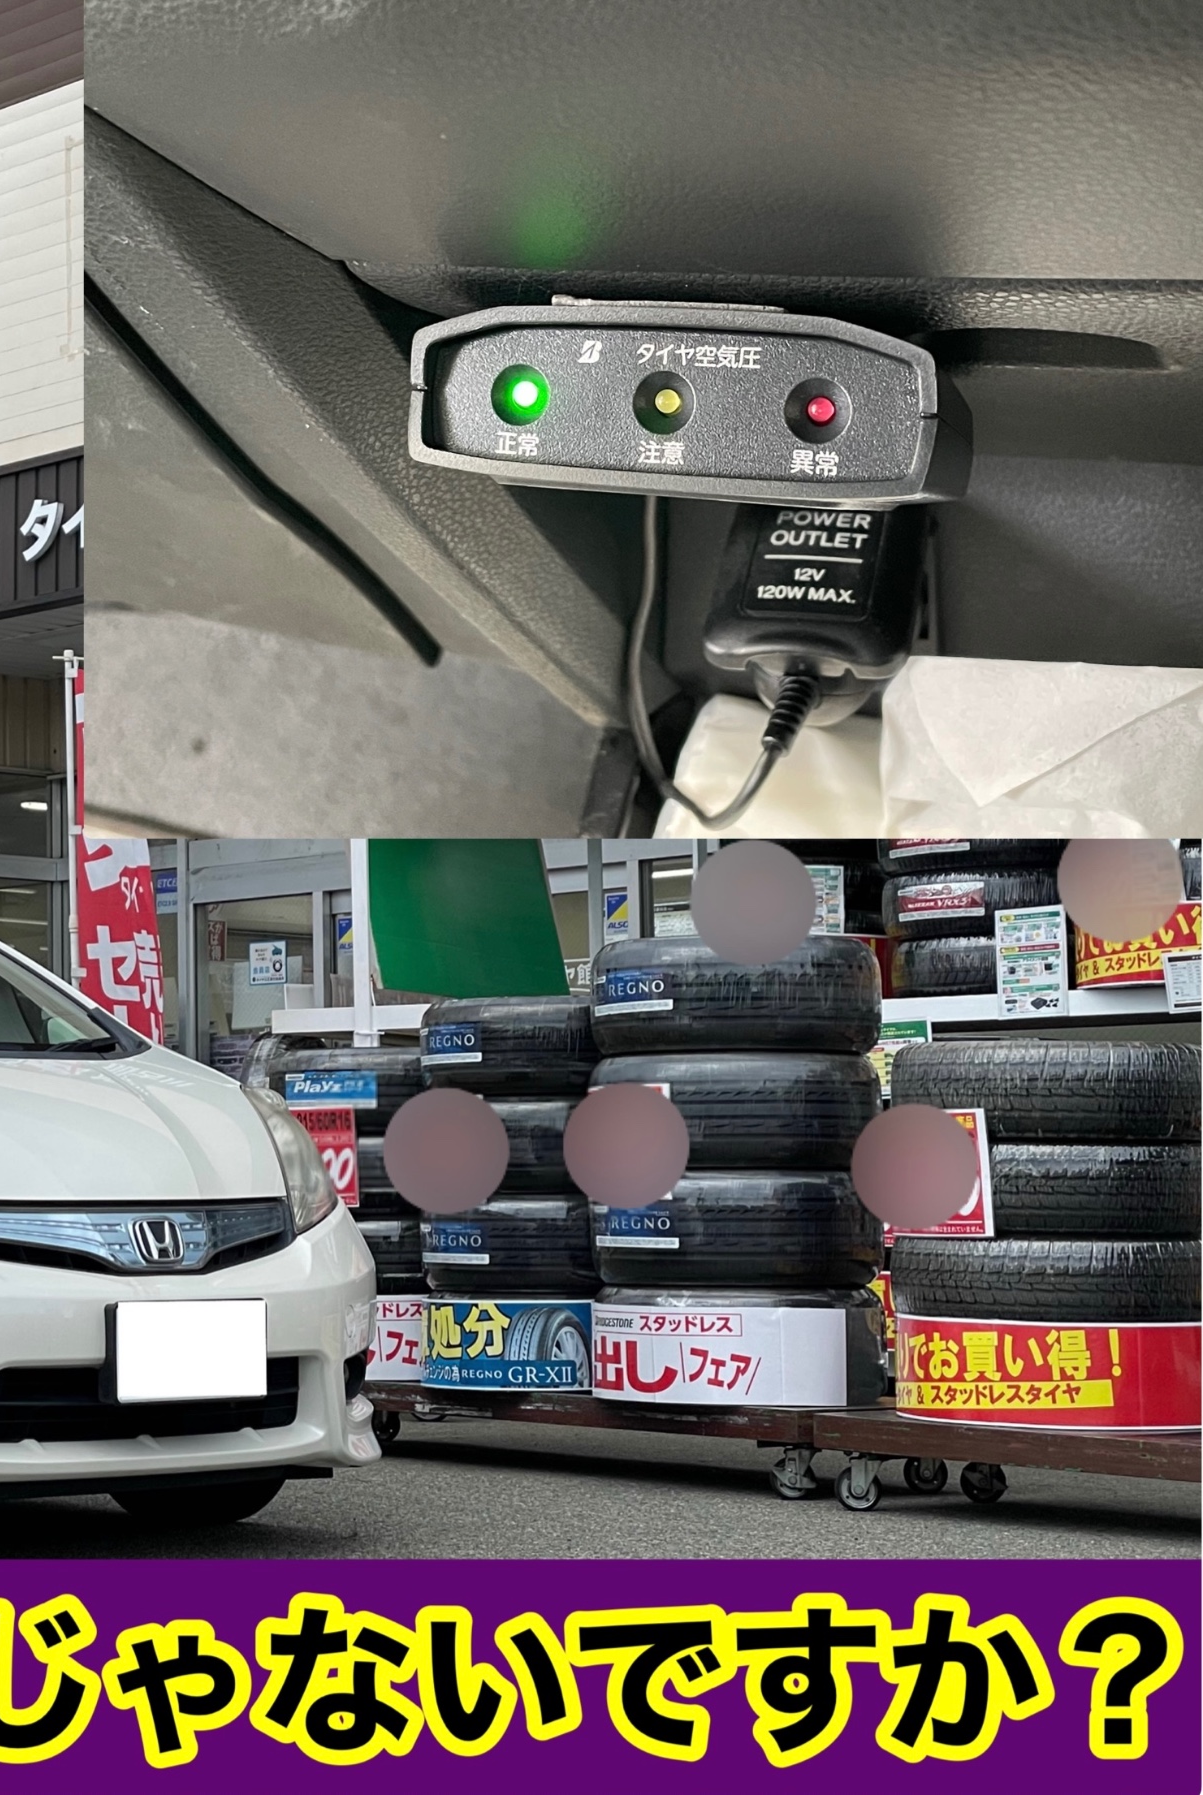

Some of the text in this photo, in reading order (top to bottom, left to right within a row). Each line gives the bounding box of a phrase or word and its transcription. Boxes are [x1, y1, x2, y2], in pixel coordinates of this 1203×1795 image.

[636, 344, 761, 369] タイヤ空気圧
[494, 433, 540, 457] 正常
[638, 441, 685, 466] 注意
[790, 449, 839, 477] 異常
[776, 510, 872, 531] POWER
[770, 531, 869, 550] OUTLET
[794, 567, 826, 582] 12V
[756, 585, 857, 604] 120W MAX.
[608, 979, 665, 997] REGNO
[428, 1033, 476, 1048] REGNO
[611, 1215, 671, 1230] REGNO
[432, 1233, 482, 1248] REGNO
[376, 1302, 423, 1318] ドレス
[422, 1301, 511, 1360] 処分
[639, 1314, 734, 1333] スタッドレス
[385, 1330, 423, 1367] フェ
[461, 1368, 503, 1380] REGNO
[689, 1347, 753, 1391] フェア
[930, 1383, 1082, 1406] スタッドレスタイヤ
